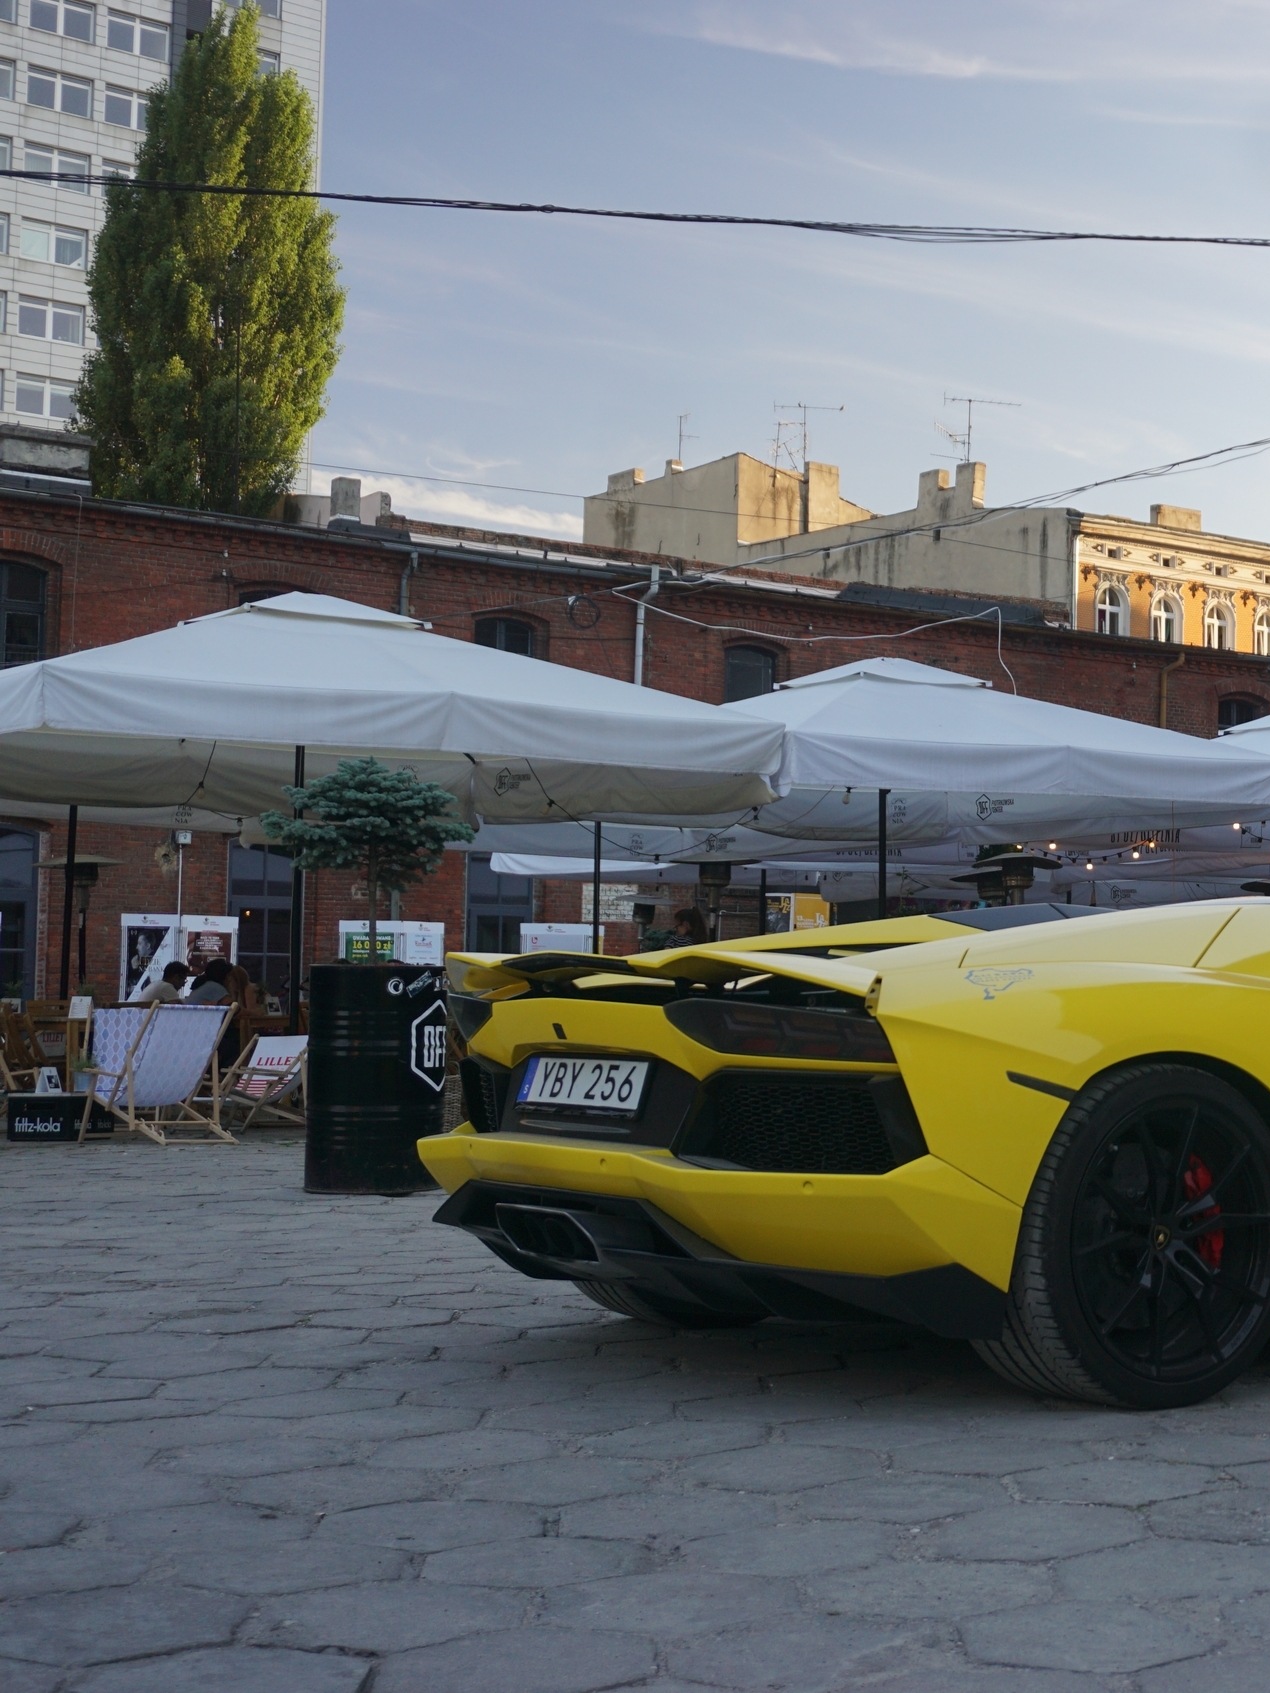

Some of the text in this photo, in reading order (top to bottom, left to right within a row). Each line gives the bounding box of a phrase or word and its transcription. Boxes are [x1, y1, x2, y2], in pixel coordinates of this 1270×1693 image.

[42, 1032, 65, 1043] LILLET
[539, 1061, 637, 1103] YBY 256
